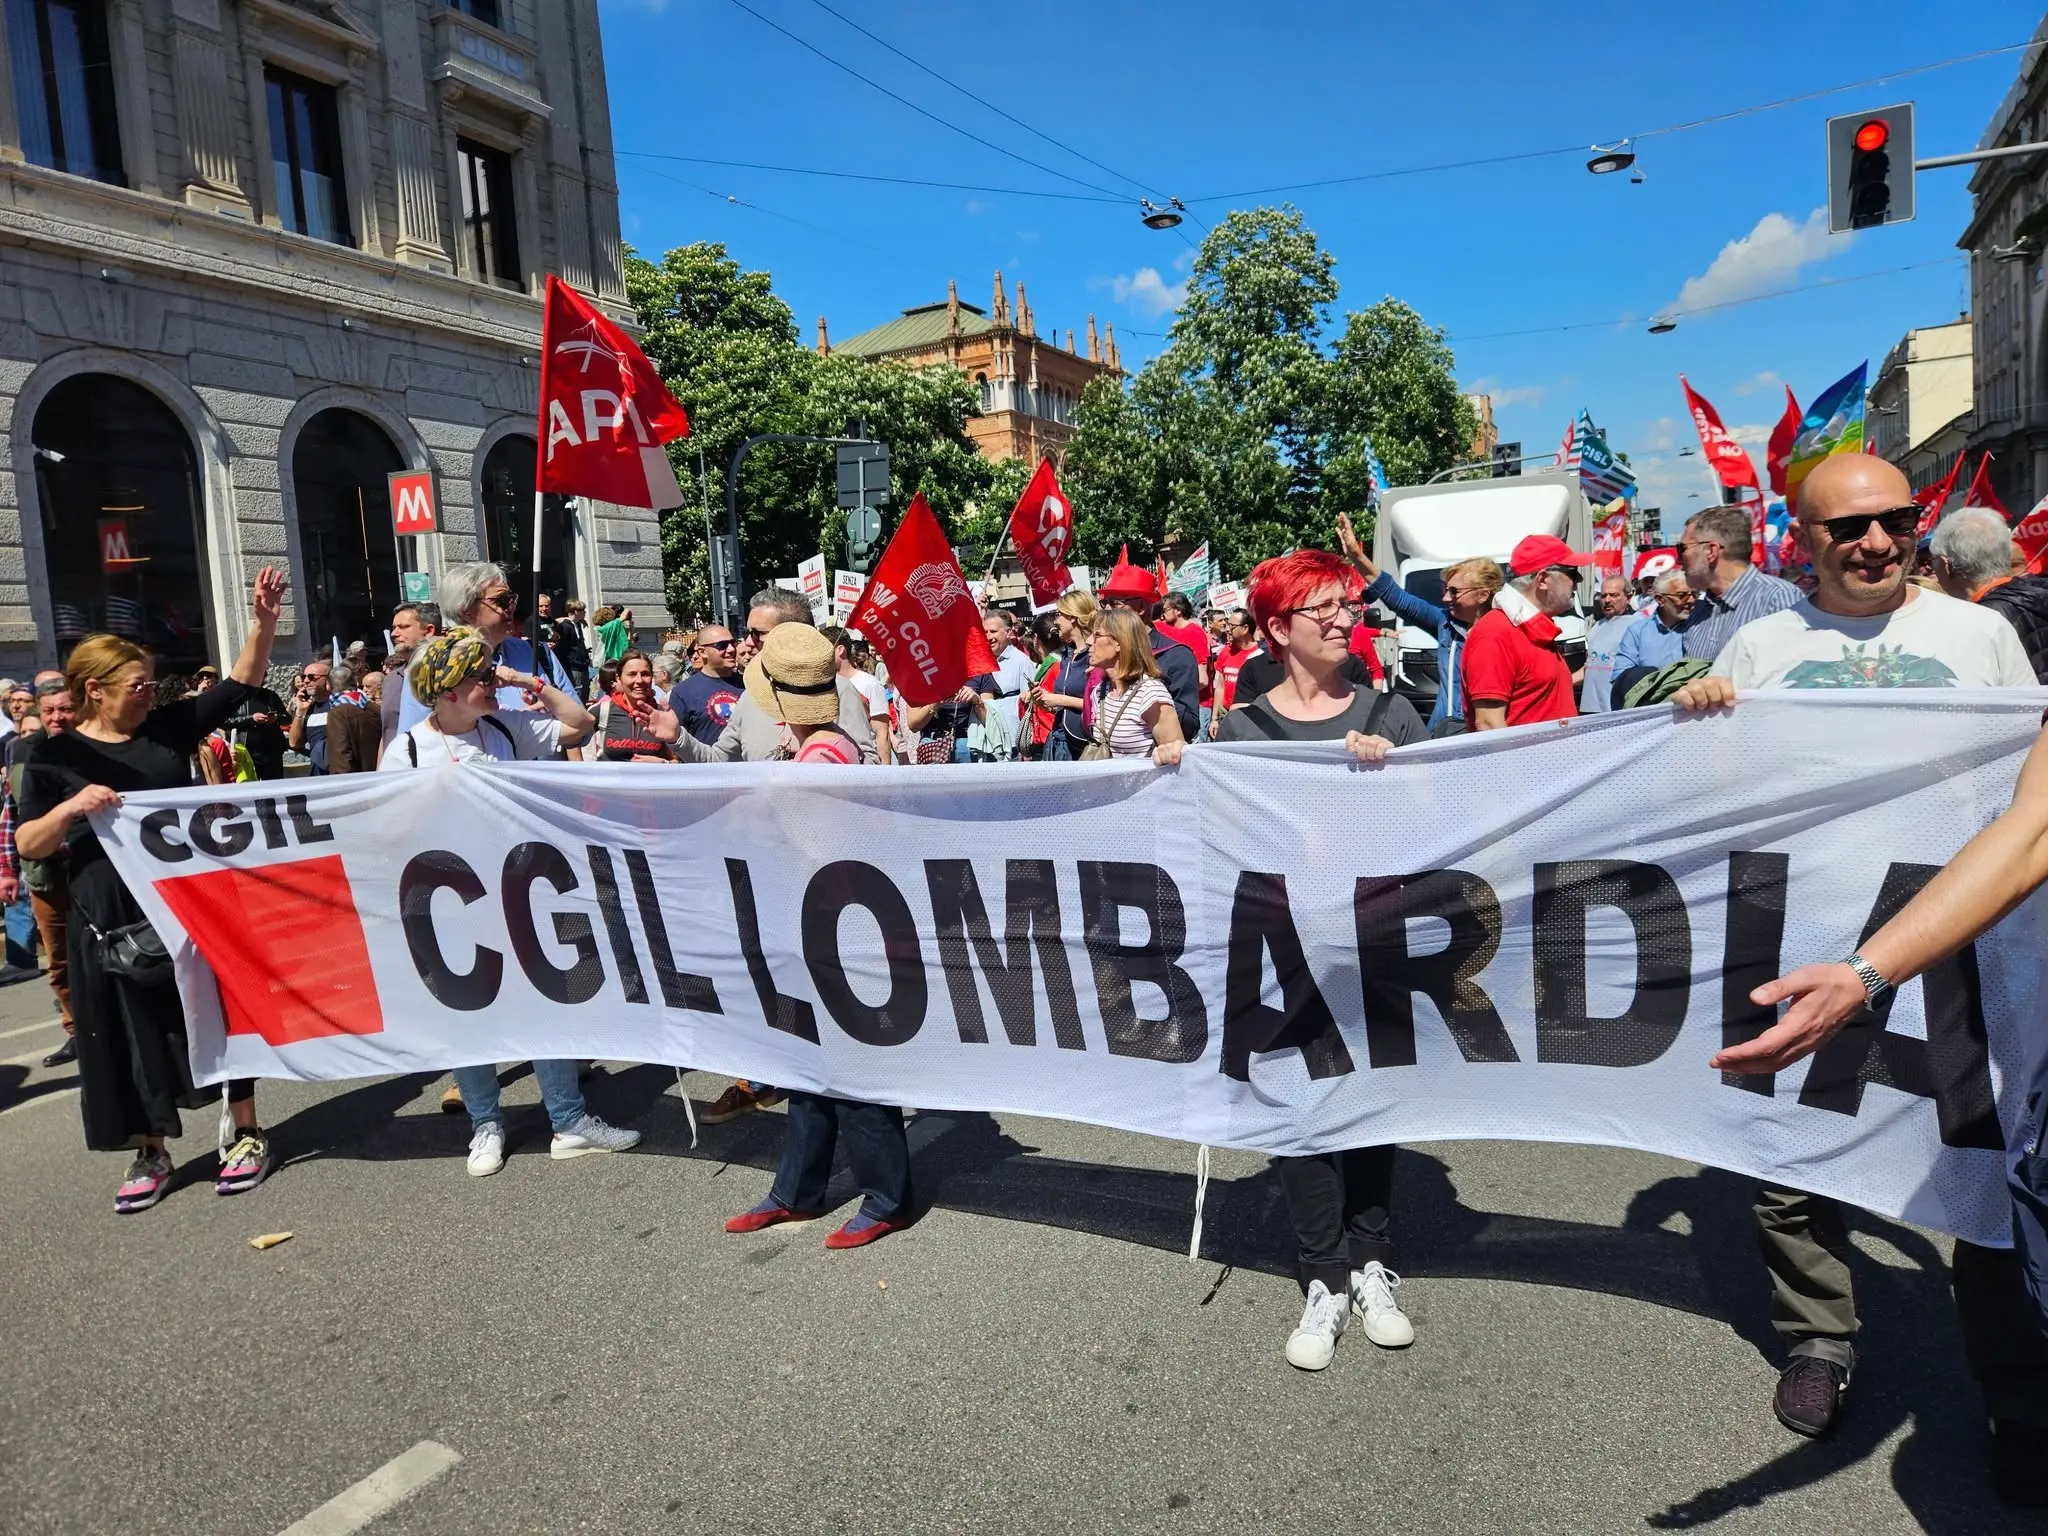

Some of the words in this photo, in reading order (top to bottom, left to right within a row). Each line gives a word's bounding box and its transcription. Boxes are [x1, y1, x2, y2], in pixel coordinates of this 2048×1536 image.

[1582, 444, 1608, 466] CISL
[396, 486, 432, 522] M
[842, 575, 857, 586] SENZA
[899, 621, 939, 686] CGIL
[140, 794, 335, 863] CGIL
[399, 841, 725, 1016] CGIL
[724, 851, 2007, 1151] LOMBARDIA
